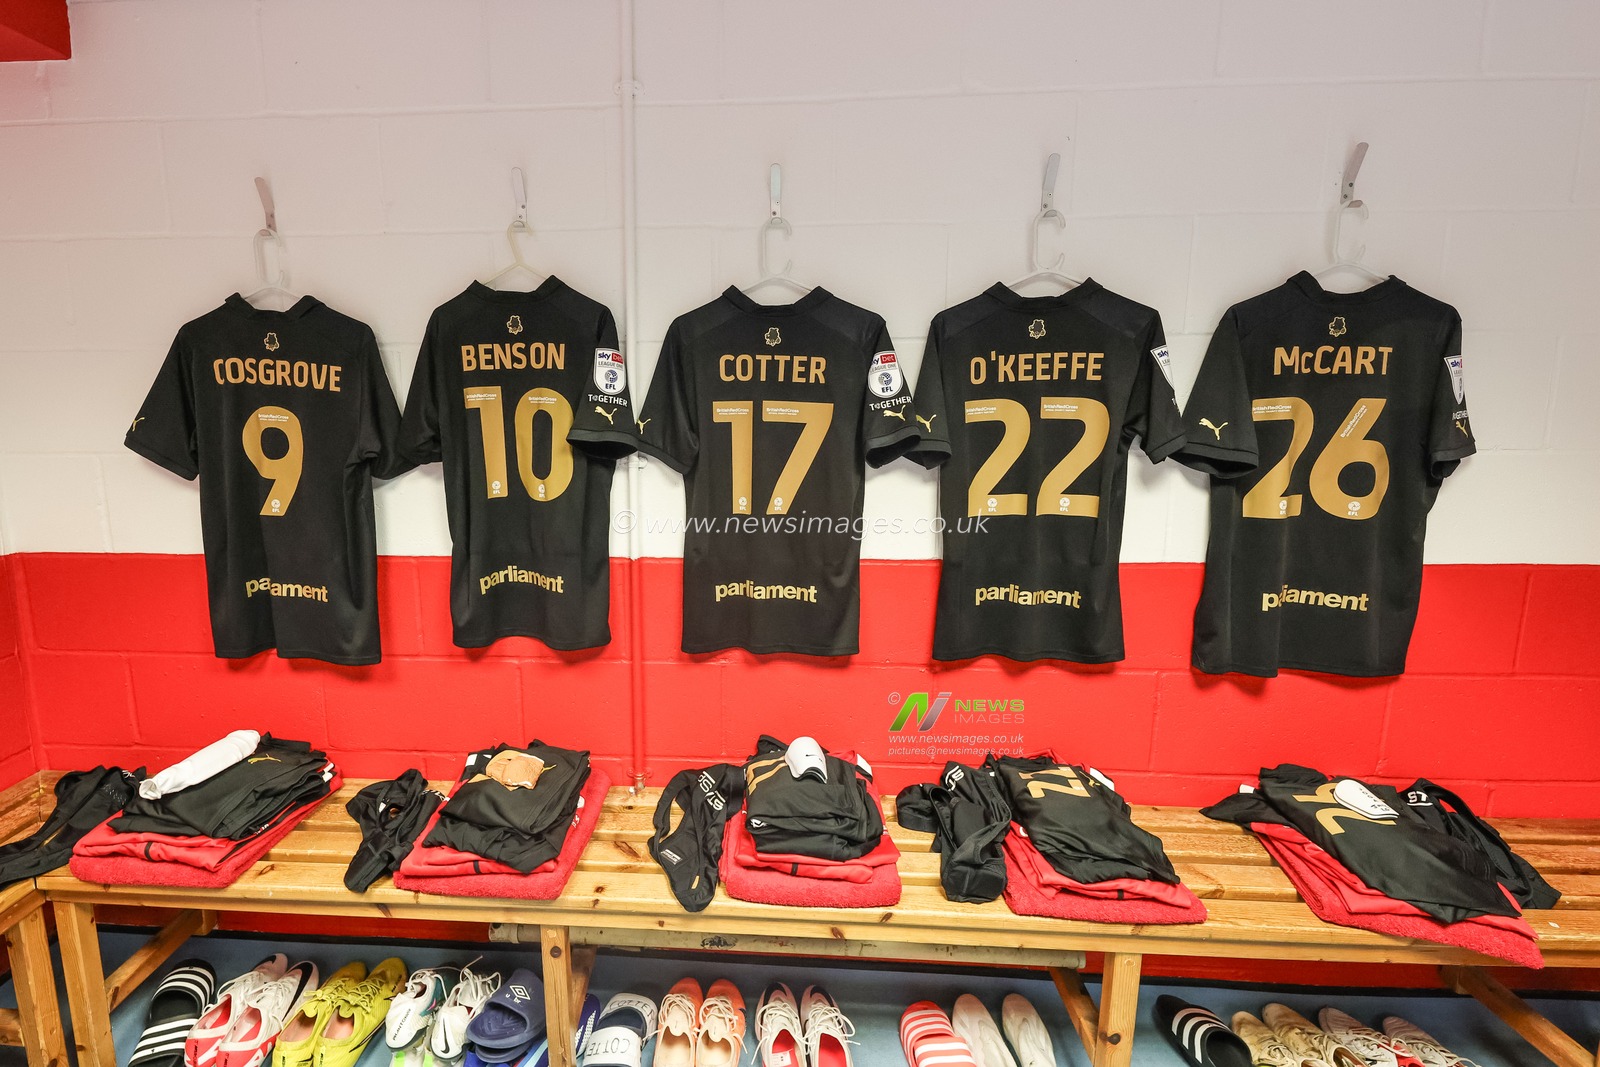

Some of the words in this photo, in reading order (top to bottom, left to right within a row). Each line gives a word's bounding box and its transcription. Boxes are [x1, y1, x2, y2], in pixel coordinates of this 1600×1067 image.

[461, 342, 566, 372] BENSON
[597, 352, 611, 360] sky
[598, 360, 616, 368] LEAGUE
[719, 354, 827, 384] COTTER
[881, 354, 895, 363] bet
[970, 350, 1105, 385] O'KEEFFE
[1273, 345, 1393, 375] McCART
[213, 357, 342, 392] COSGROVE
[605, 383, 617, 391] EFL
[881, 386, 894, 394] EFL
[463, 386, 575, 501] 10
[712, 400, 835, 516] 17
[964, 396, 1111, 518] 22
[1242, 396, 1391, 520] 26
[242, 405, 304, 517] 9
[245, 577, 329, 603] paament
[479, 565, 565, 595] parliament
[715, 580, 818, 603] parliament
[975, 584, 1082, 609] parliament
